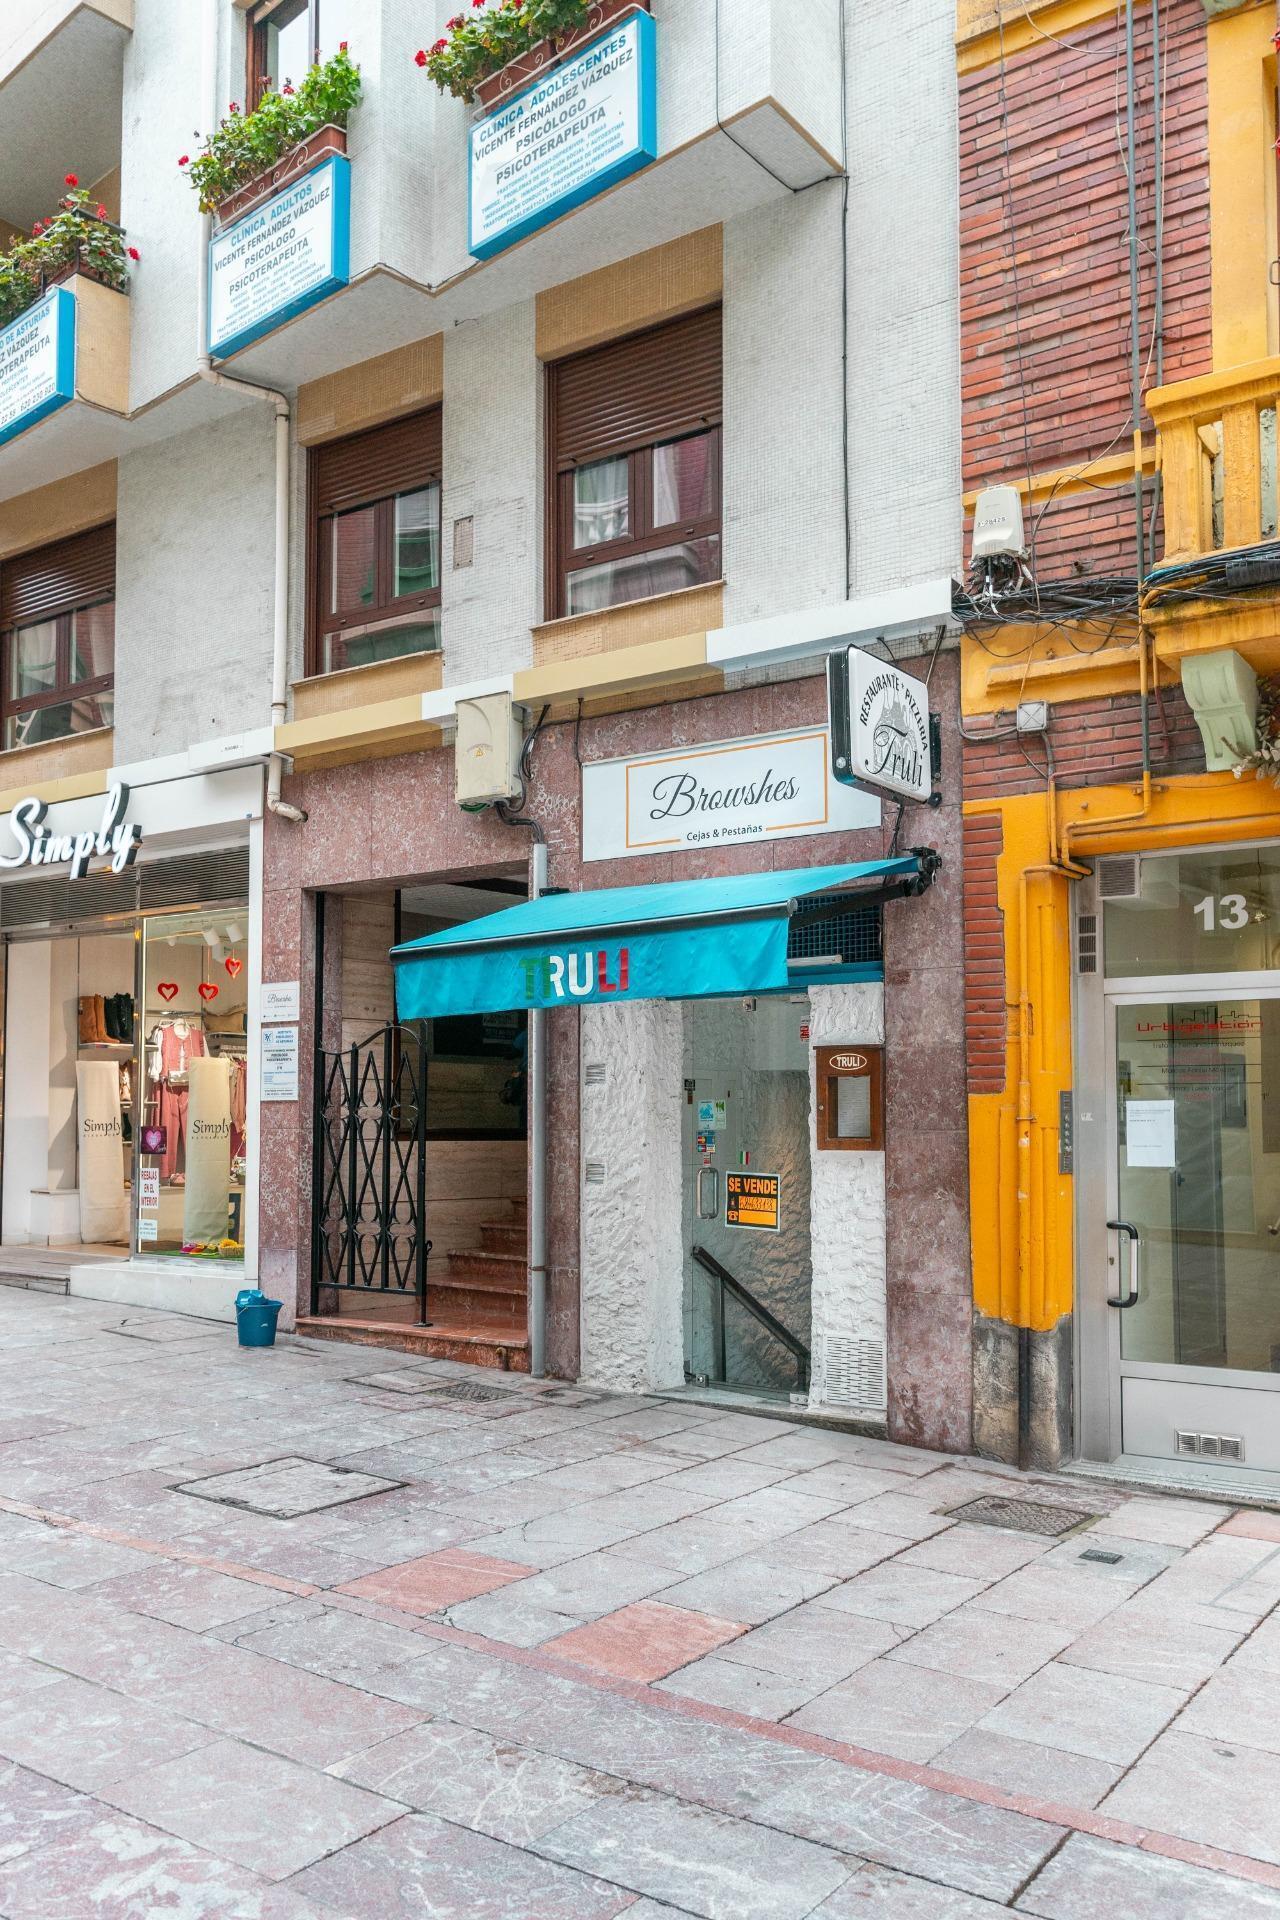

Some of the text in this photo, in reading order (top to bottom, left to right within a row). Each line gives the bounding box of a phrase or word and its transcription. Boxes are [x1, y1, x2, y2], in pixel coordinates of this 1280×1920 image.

[475, 46, 632, 161] VICENTE FERNÁNDEZ VÁZQUEZ
[480, 33, 626, 143] CLÍNICA ADOLESCENTES
[496, 104, 605, 185] PSICOTERAPEUTA
[516, 96, 586, 152] PSICÓLOGO
[214, 185, 329, 272] VICENTE FERNÁNDEZ VÁZQUEZ
[231, 182, 311, 248] CLÍNICA ADULTOS
[229, 235, 308, 296] PSICOTERAPEUTA
[244, 226, 295, 269] PSICÓLOGO
[5, 331, 14, 345] DE
[16, 305, 49, 337] ASTURIAS
[6, 325, 38, 358] VÁZQUEZ
[860, 673, 928, 751] RESTAURANTE PIZZERIA
[865, 724, 923, 787] Truli
[650, 768, 800, 820] Browshes
[0, 781, 138, 881] Simply
[686, 824, 763, 842] Cejas & Pestañas
[1193, 894, 1249, 931] 13
[519, 947, 629, 1000] TRULI
[836, 1056, 860, 1068] TRULI
[84, 1116, 121, 1136] Simply
[193, 1117, 231, 1138] Simply
[141, 1171, 157, 1181] REBAJAS
[728, 1177, 778, 1195] SE VENDE
